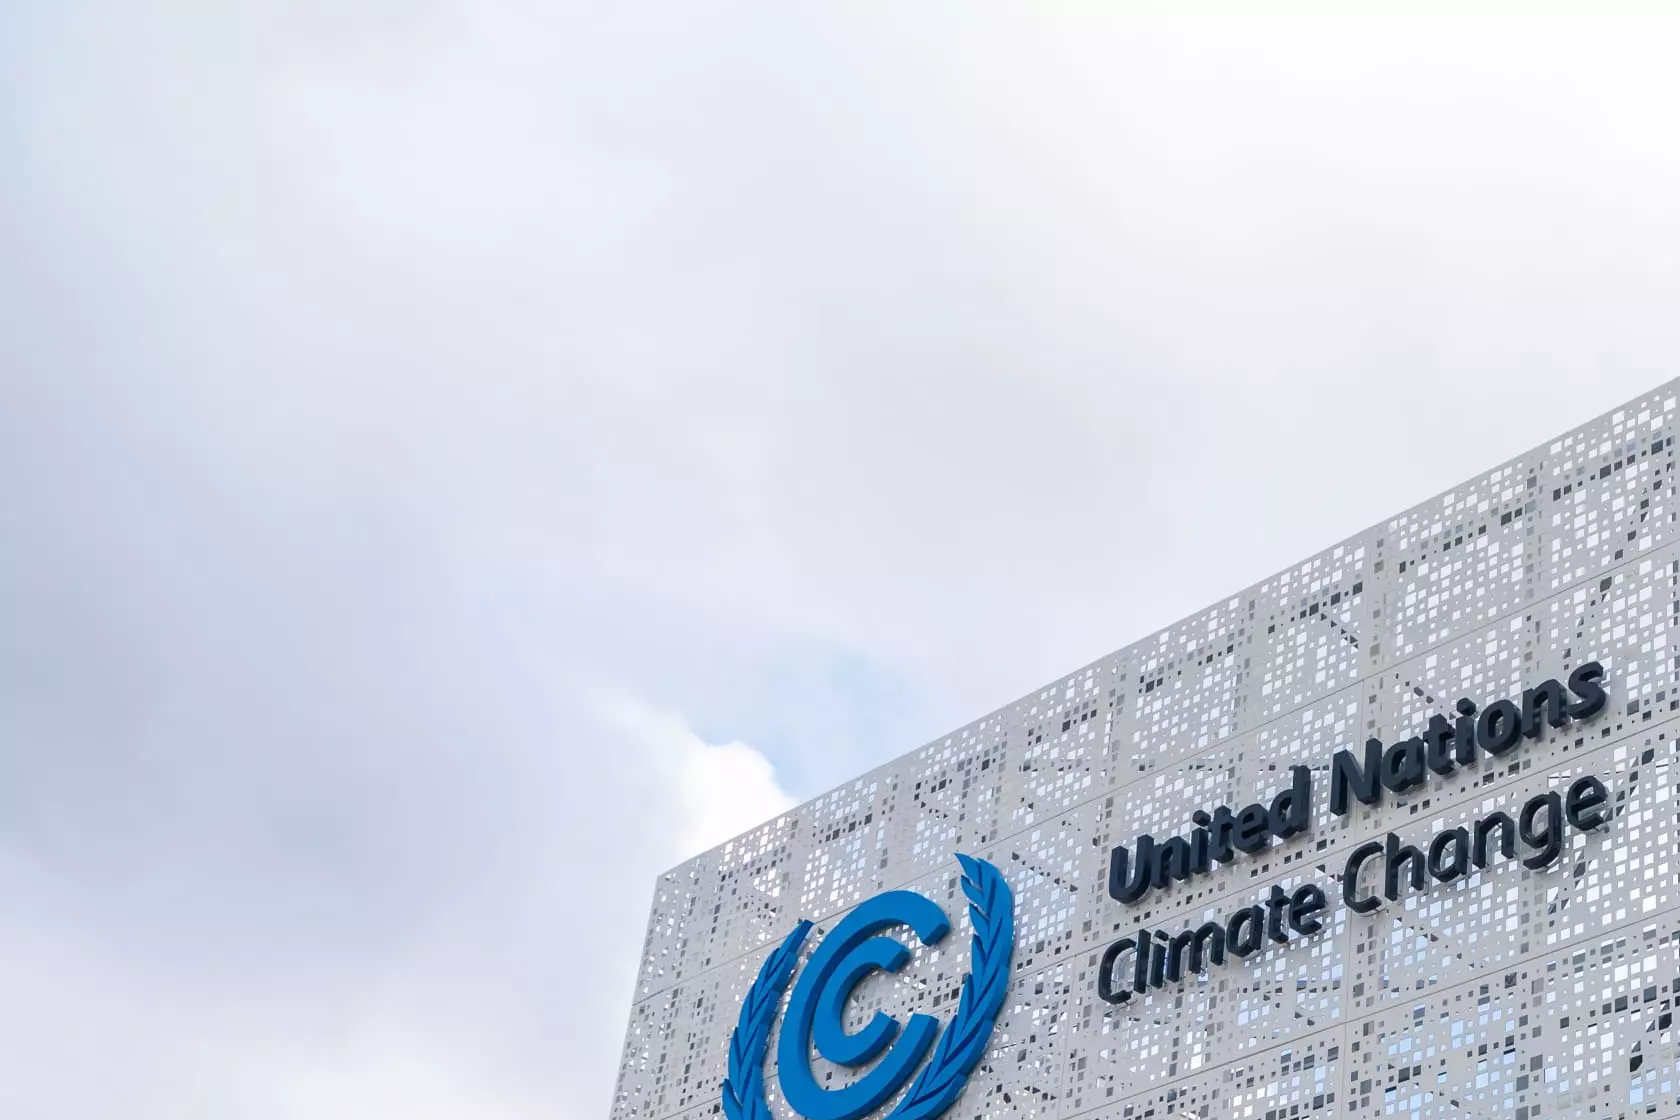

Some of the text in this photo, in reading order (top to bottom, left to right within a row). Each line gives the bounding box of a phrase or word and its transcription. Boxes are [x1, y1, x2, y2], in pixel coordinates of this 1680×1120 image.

[1098, 775, 1609, 1004] Climate Change
[1108, 661, 1609, 905] United Nations
